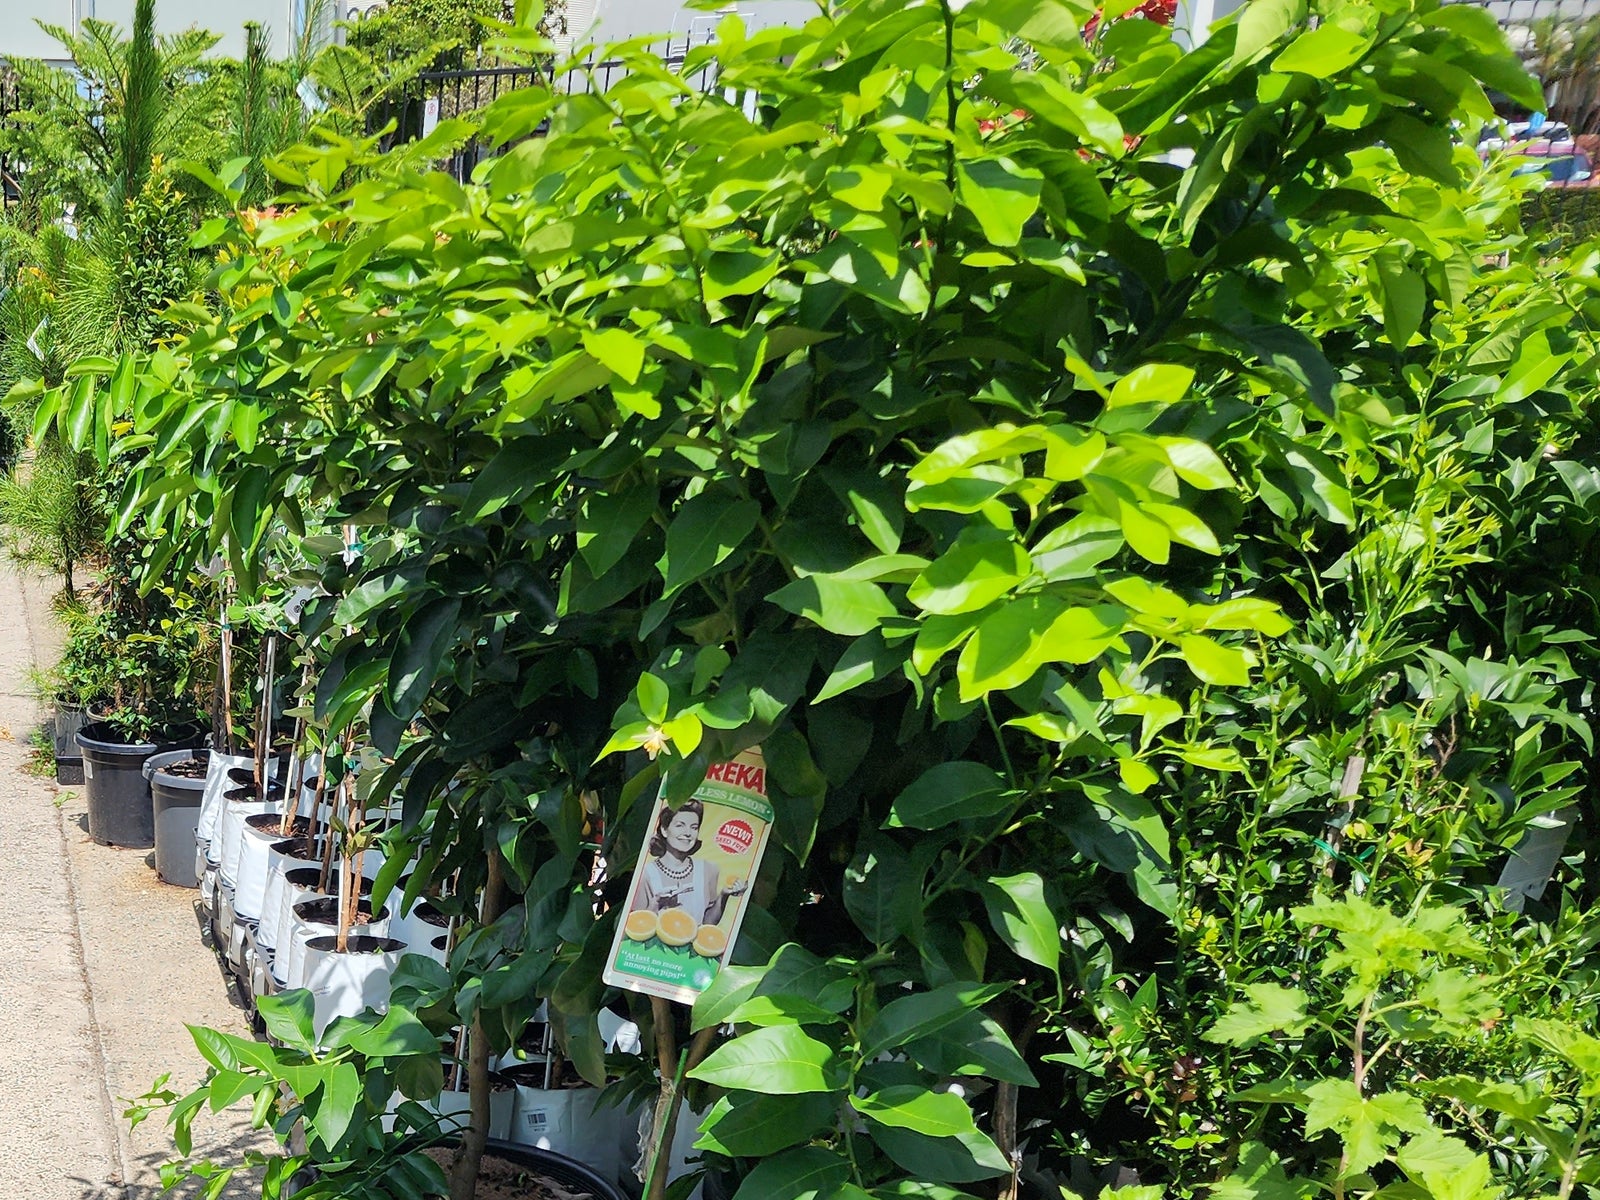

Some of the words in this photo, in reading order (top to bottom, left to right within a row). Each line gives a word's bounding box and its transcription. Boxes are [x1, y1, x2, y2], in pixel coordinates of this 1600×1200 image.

[706, 762, 764, 794] REKA
[723, 824, 751, 843] NEW!
[623, 960, 660, 976] annoying
[662, 962, 684, 972] more
